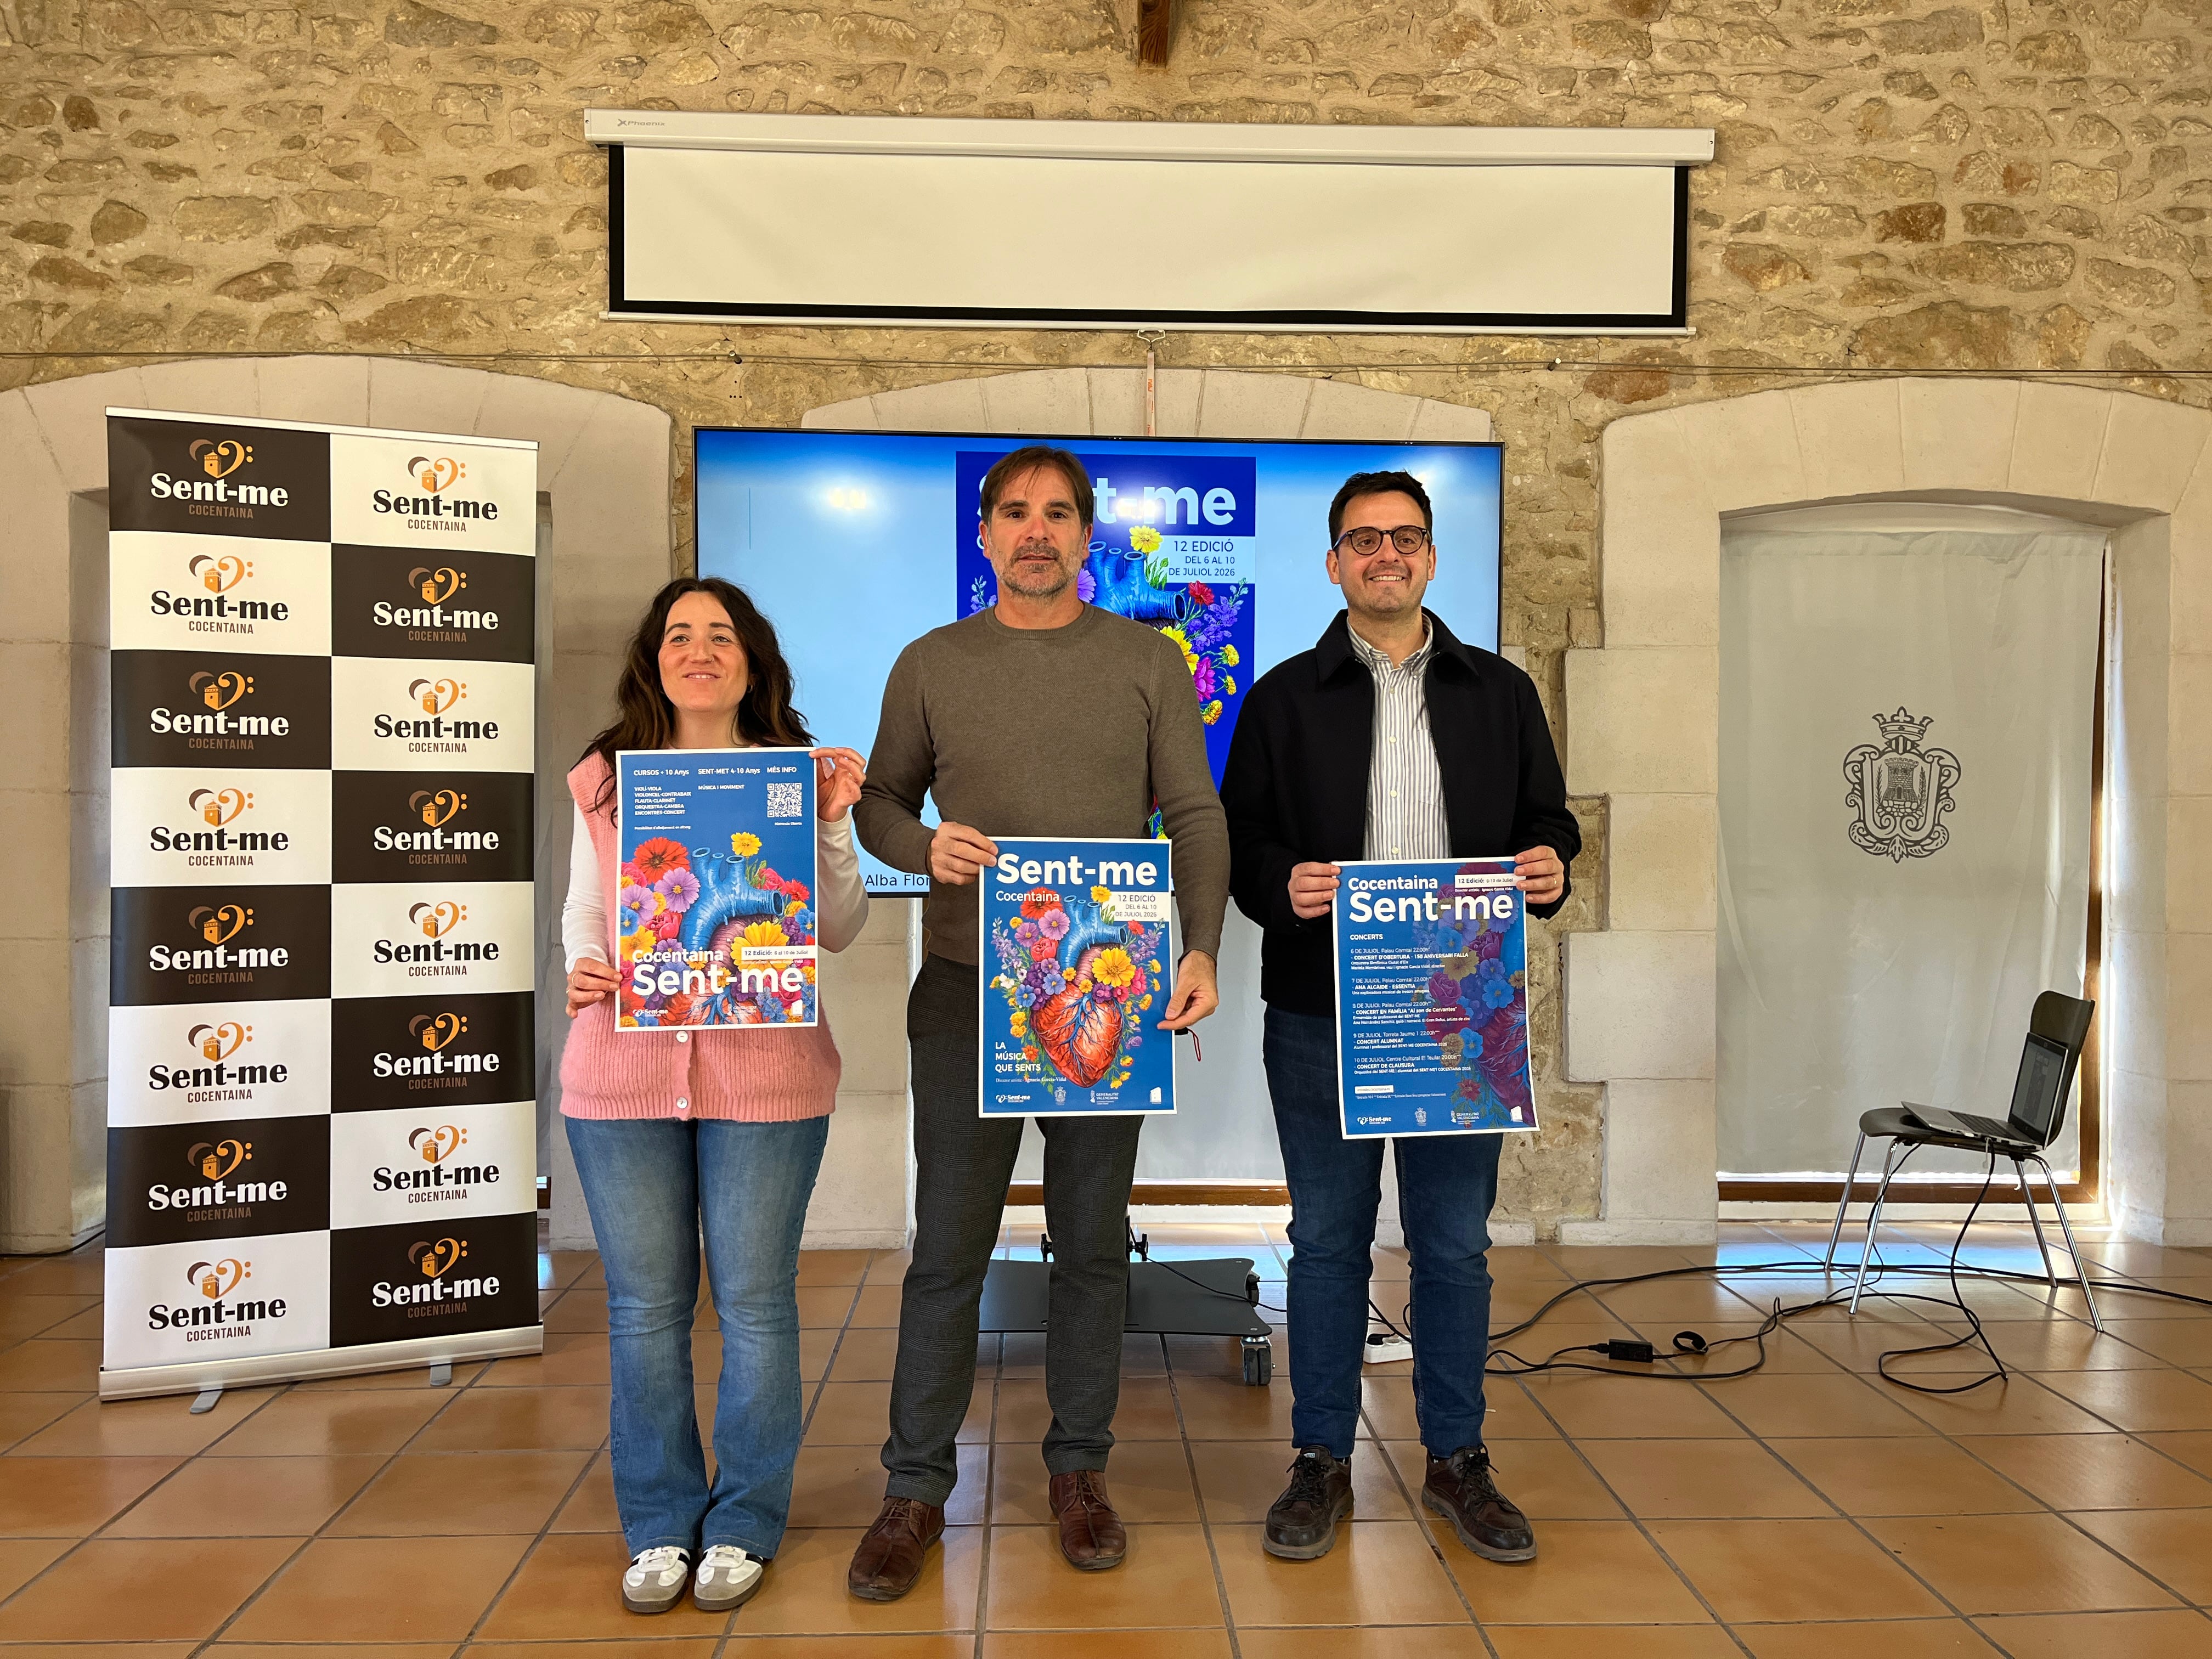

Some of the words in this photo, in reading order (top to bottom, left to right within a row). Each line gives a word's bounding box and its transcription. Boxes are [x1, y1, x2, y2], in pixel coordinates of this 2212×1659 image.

[150, 472, 289, 507] Sent-me
[189, 504, 253, 518] COCENTAINA
[373, 490, 498, 520] Sent-me
[408, 518, 466, 532] COCENTAINA
[1175, 540, 1187, 552] 12
[1192, 538, 1234, 552] EDICIÓ
[1185, 555, 1201, 564] DEL
[1204, 555, 1210, 564] 6
[1211, 556, 1223, 564] AL
[1226, 556, 1235, 564] 10
[1169, 567, 1180, 576] DE
[1182, 567, 1213, 576] JULIOL
[1214, 567, 1235, 576] 2026
[151, 590, 289, 621] Sent-me
[373, 601, 499, 630] Sent-me
[189, 620, 253, 634] COCENTAINA
[408, 630, 467, 644] COCENTAINA
[150, 708, 289, 735] Sent-me
[374, 714, 498, 741] Sent-me
[189, 738, 254, 750] COCENTAINA
[409, 742, 467, 753] COCENTAINA
[150, 826, 289, 851] Sent-me
[374, 826, 499, 850] Sent-me
[188, 855, 253, 866] COCENTAINA
[409, 854, 467, 865] COCENTAINA
[996, 853, 1158, 885] Sent-me
[865, 874, 897, 886] Alba
[1348, 874, 1438, 890] Cocentaina
[996, 890, 1059, 902] Cocentaina
[1130, 893, 1155, 902] EDICIÓ
[1349, 891, 1514, 923] Sent-me
[149, 945, 289, 971] Sent-me
[374, 939, 499, 963] Sent-me
[632, 947, 723, 963] Cocentaina
[188, 973, 253, 984] COCENTAINA
[409, 966, 467, 977] COCENTAINA
[632, 964, 803, 996] Sent-me
[995, 1051, 1028, 1060] MÚSICA
[373, 1051, 499, 1077] Sent-me
[995, 1064, 1013, 1073] QUE
[149, 1063, 287, 1090] Sent-me
[408, 1077, 467, 1090] COCENTAINA
[187, 1090, 252, 1103] COCENTAINA
[373, 1163, 499, 1192] Sent-me
[148, 1181, 287, 1210] Sent-me
[408, 1189, 467, 1204] COCENTAINA
[187, 1207, 252, 1222] COCENTAINA
[372, 1276, 500, 1307] Sent-me
[148, 1298, 286, 1330] Sent-me
[407, 1302, 467, 1319] COCENTAINA
[186, 1325, 251, 1342] COCENTAINA
